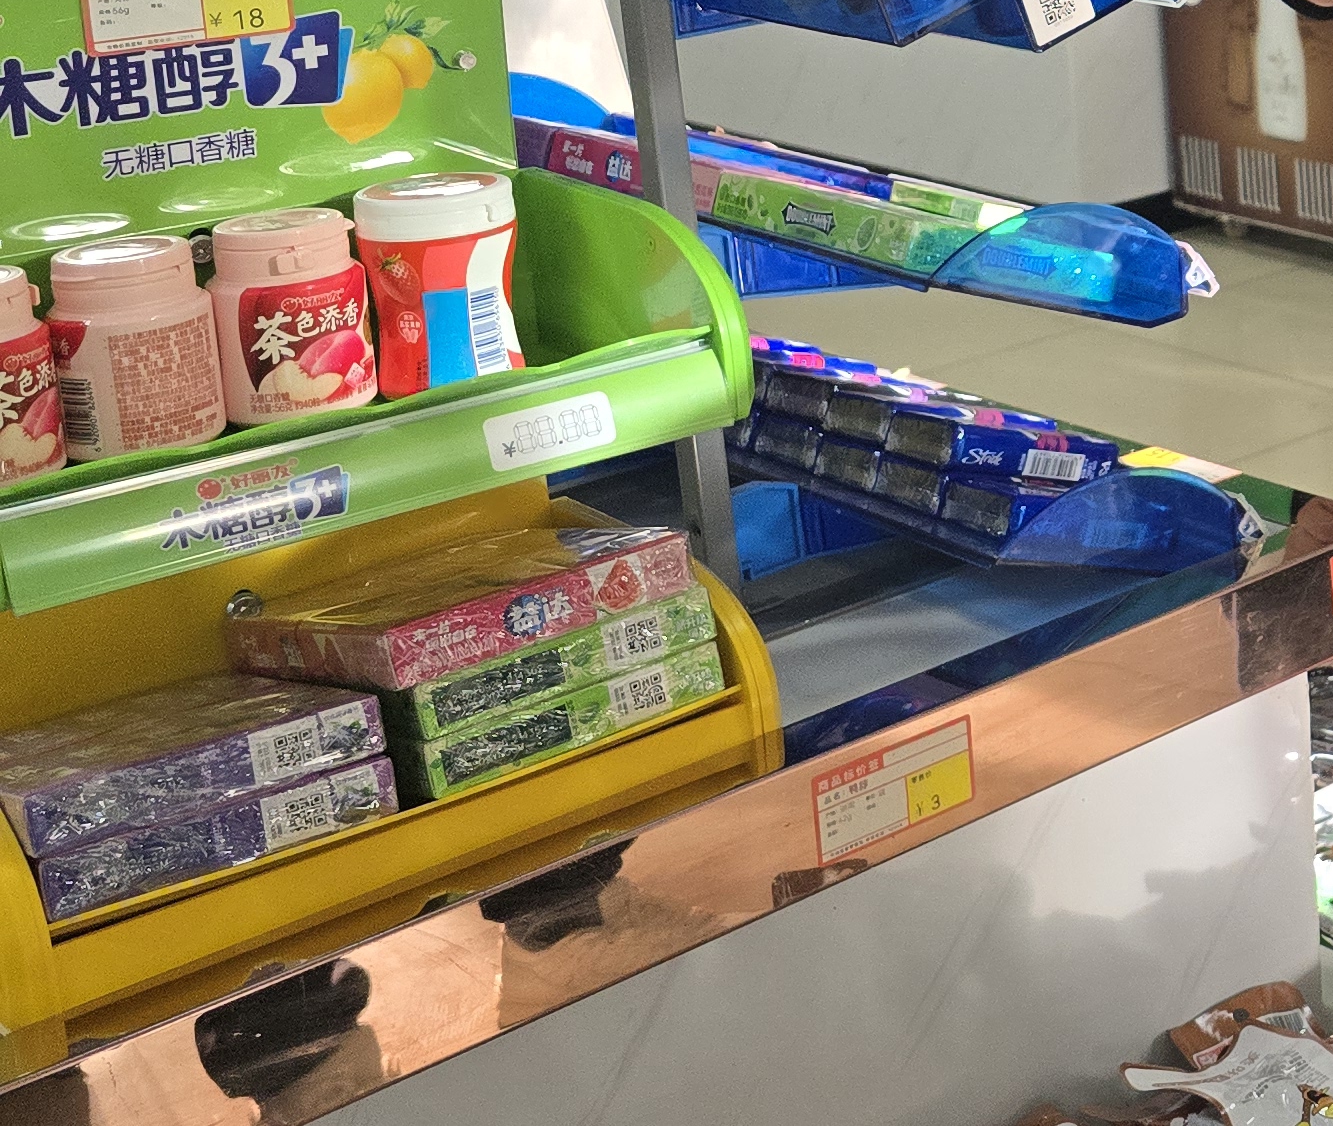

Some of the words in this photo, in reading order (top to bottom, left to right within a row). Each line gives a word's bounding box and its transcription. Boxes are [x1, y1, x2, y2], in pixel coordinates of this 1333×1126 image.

[232, 7, 265, 30] 18
[0, 38, 240, 137] 木糖醇
[251, 32, 331, 106] 3+
[103, 129, 256, 179] 无糖口香糖
[606, 155, 633, 182] 益达
[250, 297, 360, 365] 茶色添香
[230, 465, 292, 490] 好丽友
[295, 477, 336, 521] 3+
[506, 588, 575, 632] 益达
[817, 758, 880, 793] 商品标价签
[931, 793, 942, 811] 3
